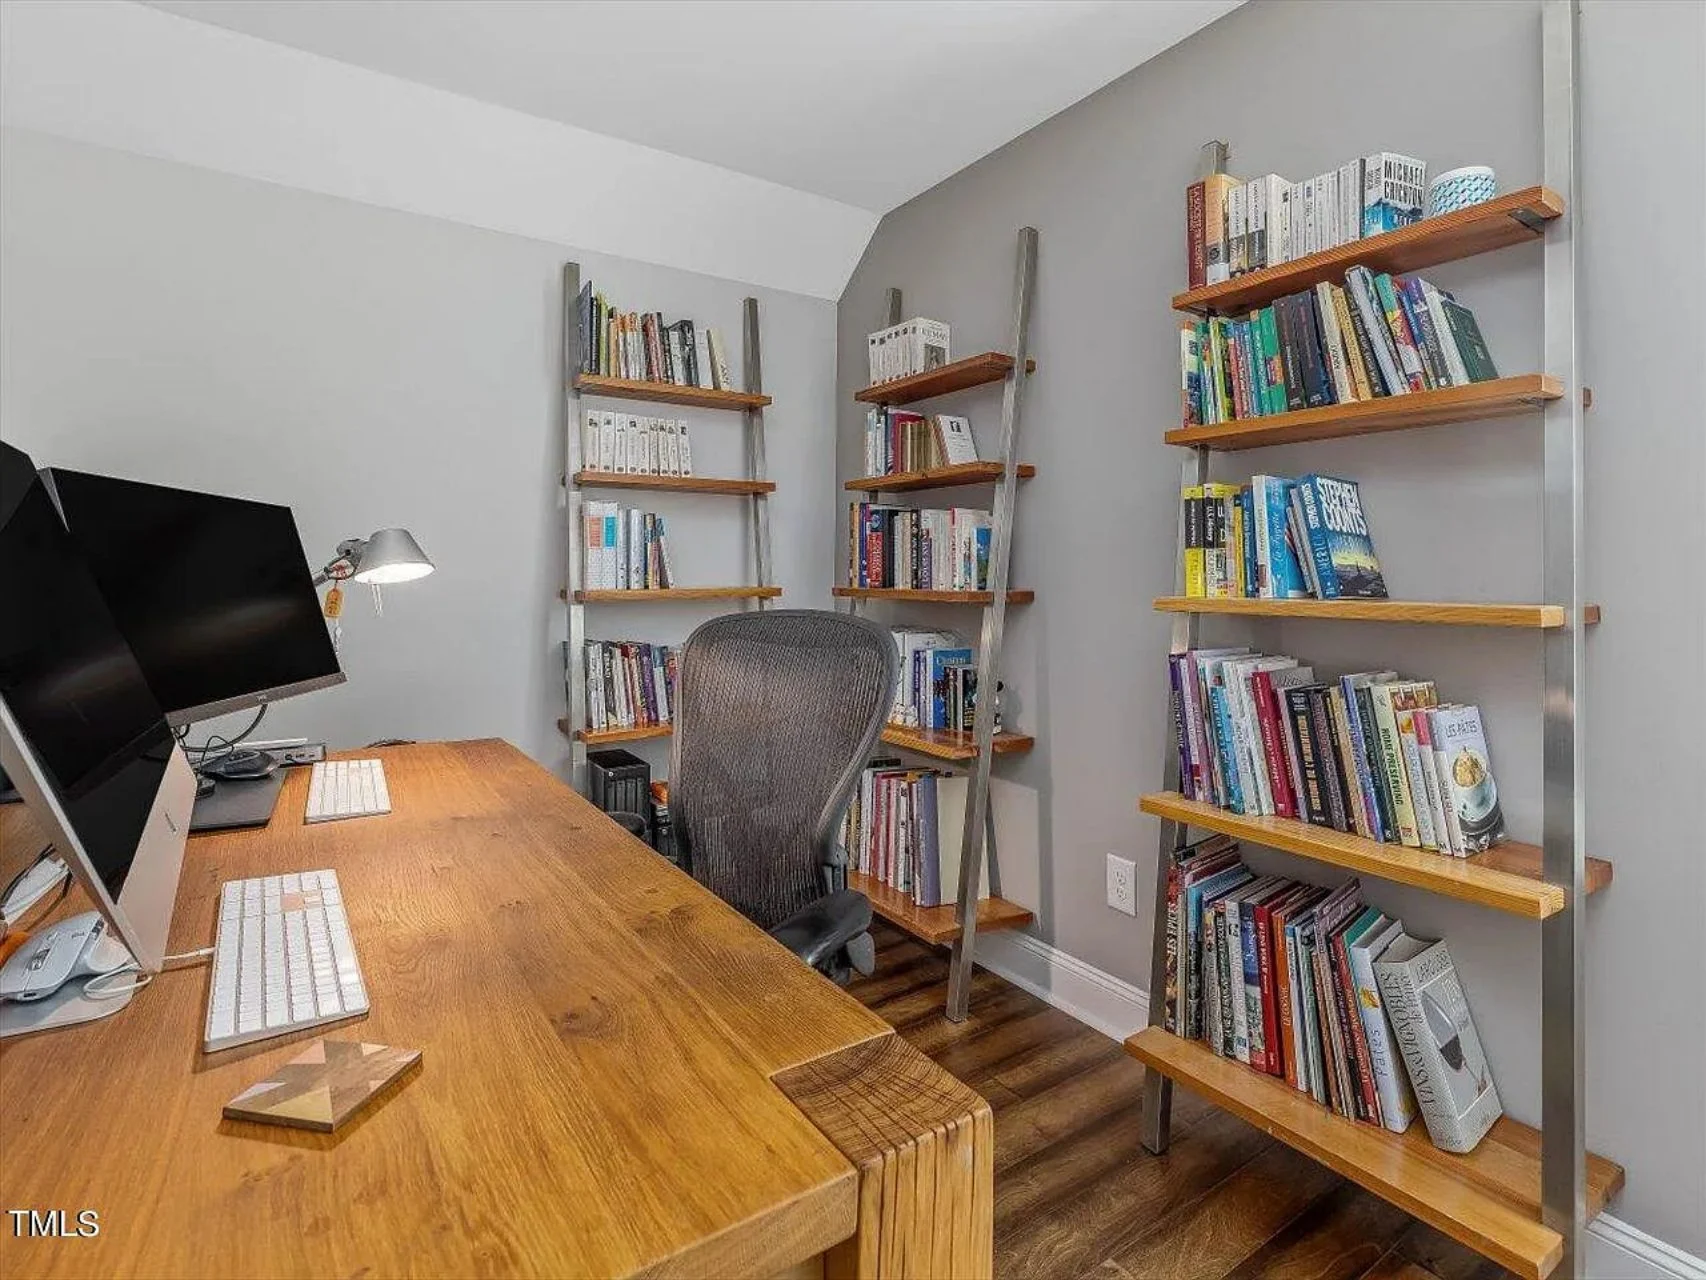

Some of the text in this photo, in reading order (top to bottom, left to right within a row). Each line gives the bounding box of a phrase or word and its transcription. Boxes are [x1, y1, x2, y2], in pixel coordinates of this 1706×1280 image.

[1384, 160, 1423, 187] MICHAEL
[1384, 181, 1423, 206] CRICHTON
[1317, 477, 1361, 515] STEPHEN
[1322, 502, 1367, 536] COONTS
[1381, 728, 1404, 805] HOME PRESERVING
[1381, 972, 1419, 1055] VIGNOBLES
